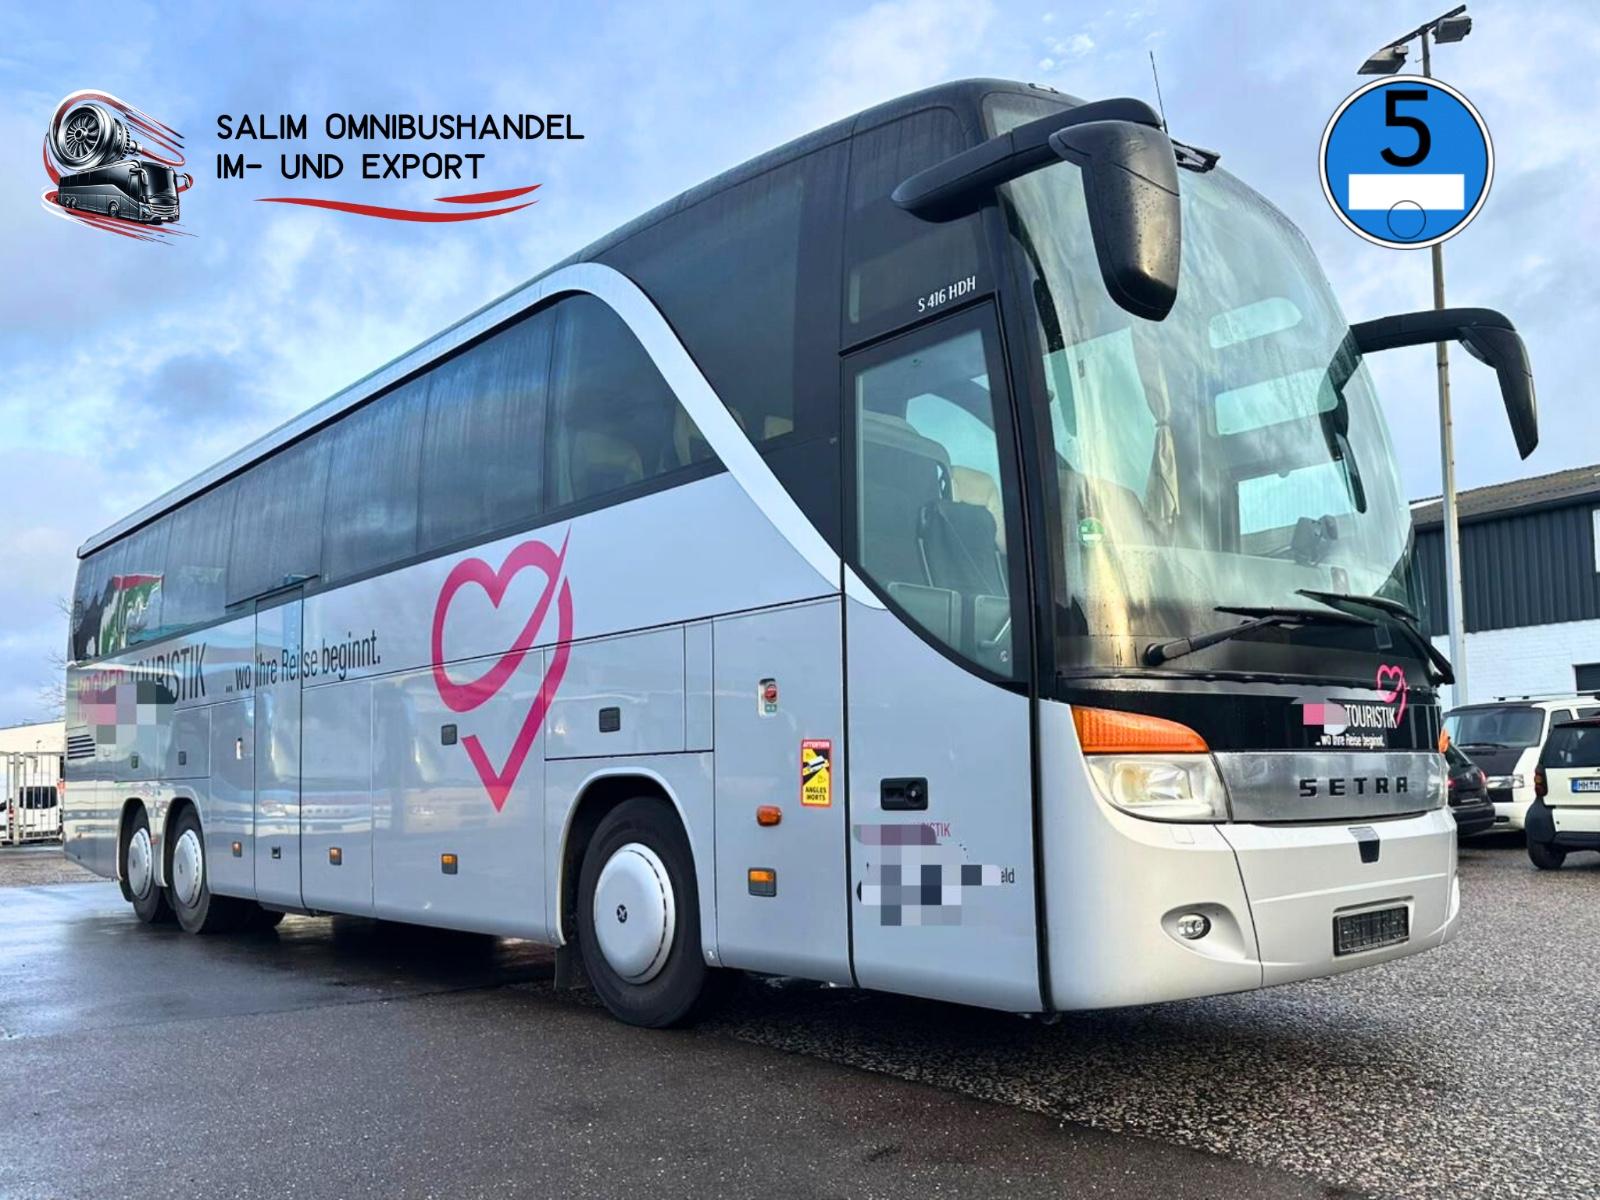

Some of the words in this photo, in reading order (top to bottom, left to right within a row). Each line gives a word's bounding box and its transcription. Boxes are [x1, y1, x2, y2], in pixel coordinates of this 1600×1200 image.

[918, 297, 926, 313] S
[927, 288, 946, 308] 416
[948, 275, 976, 300] HDH
[256, 652, 277, 687] Ihre
[281, 644, 318, 683] Reise
[321, 629, 381, 681] beginnt.
[1344, 704, 1398, 729] TOURISTIK
[1300, 777, 1408, 797] SETRA
